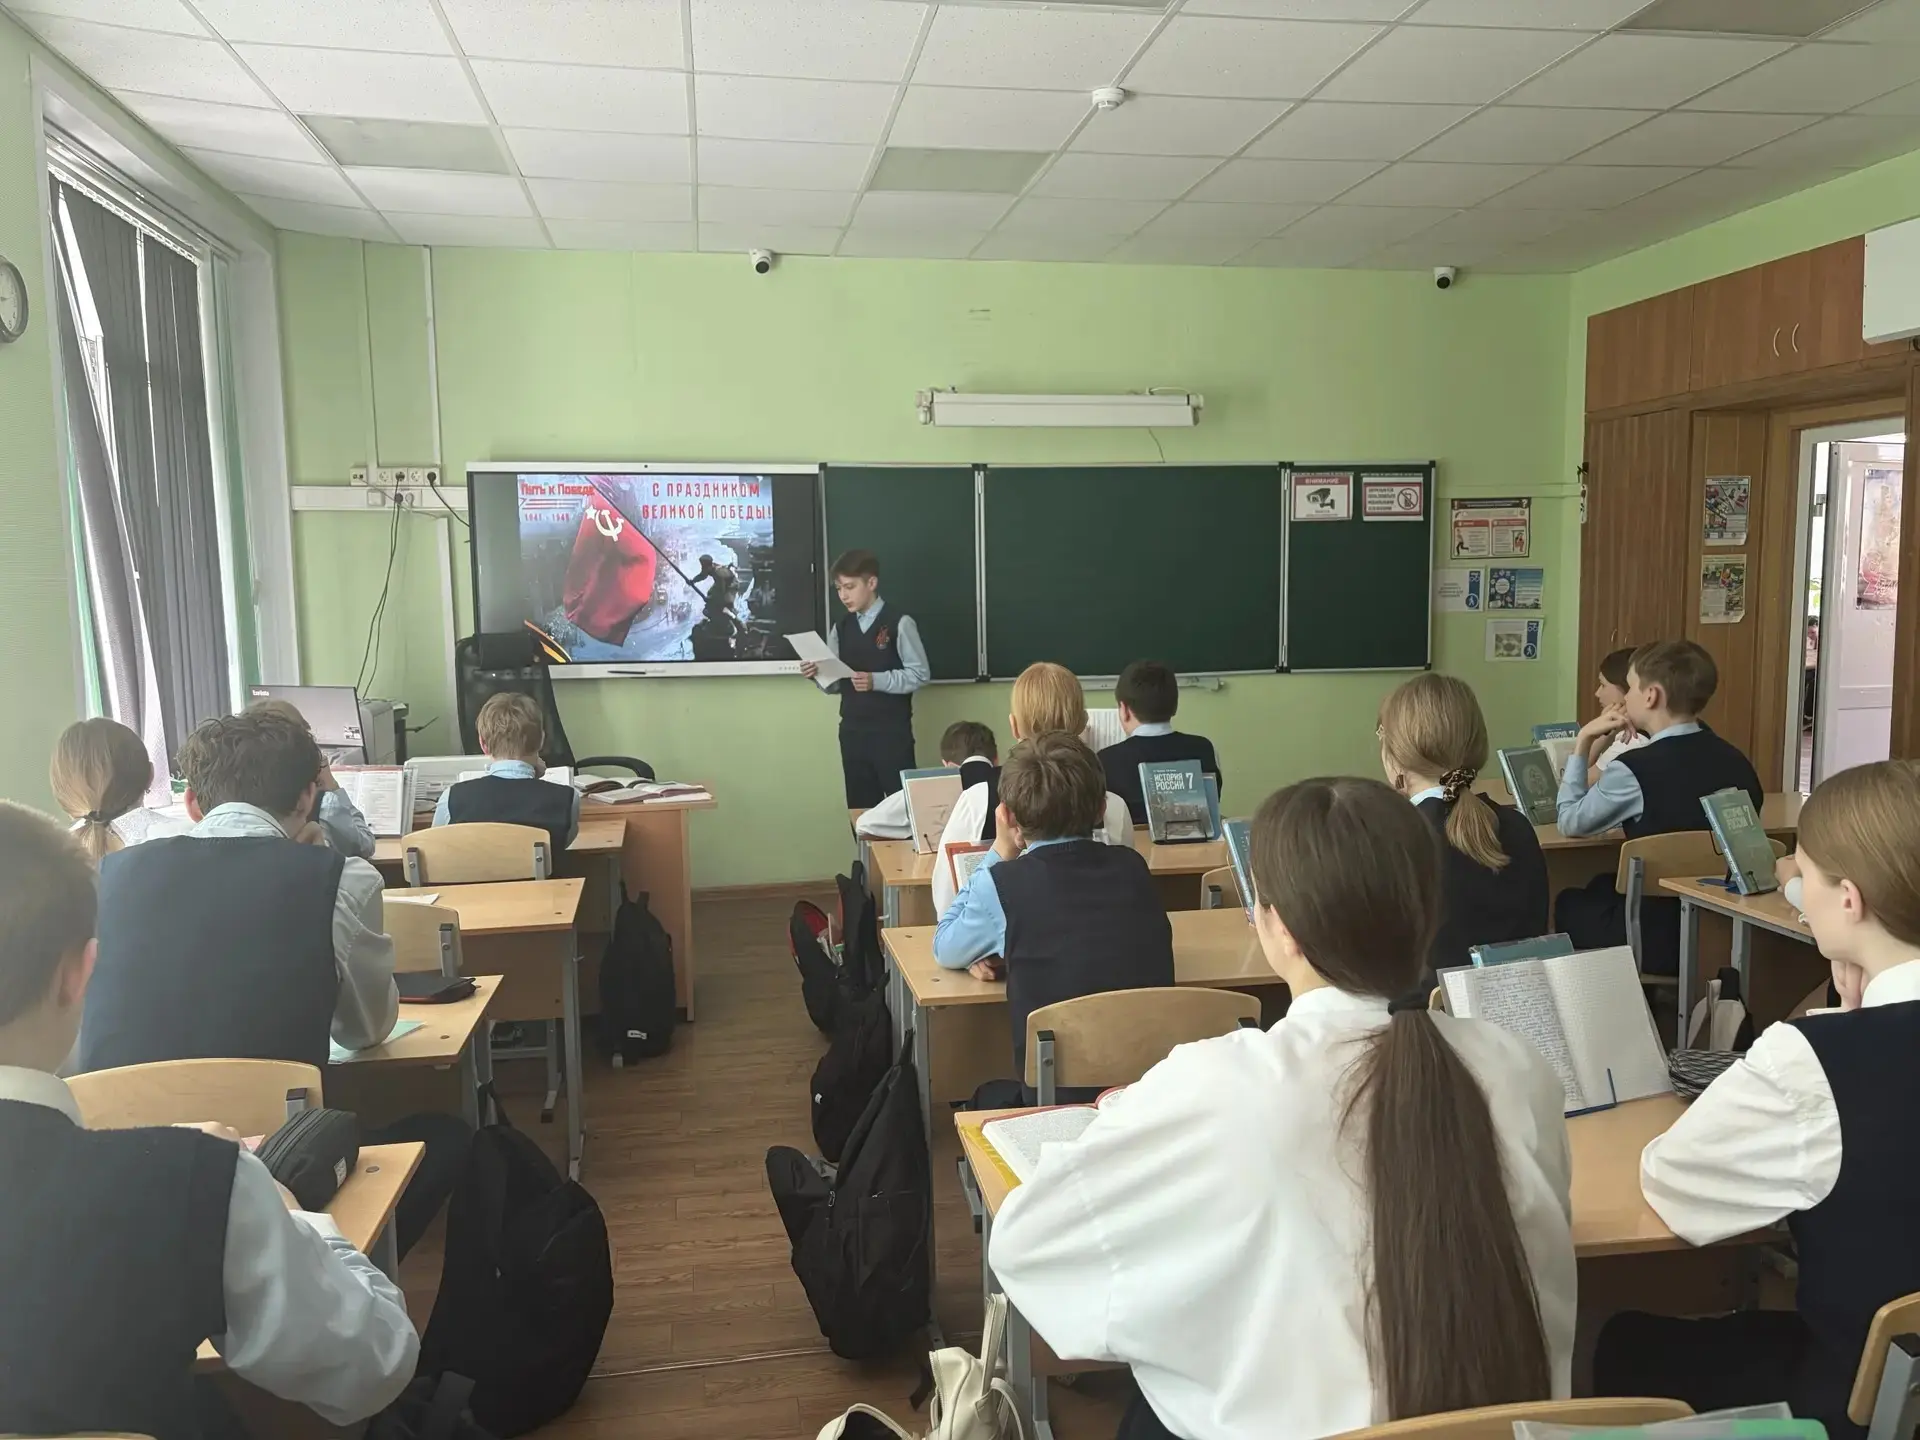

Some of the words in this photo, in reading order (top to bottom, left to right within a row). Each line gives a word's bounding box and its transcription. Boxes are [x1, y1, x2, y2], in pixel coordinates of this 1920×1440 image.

[652, 482, 660, 498] С
[667, 482, 760, 499] ПРАЗДНИКОМ
[642, 502, 704, 520] ВЕЛИКОЙ
[711, 504, 772, 521] ПОБЕДЫ!
[1154, 773, 1184, 782] ИСТОРИЯ
[1155, 780, 1185, 790] РОССИИ
[1186, 772, 1194, 789] 7
[1742, 804, 1754, 826] 7
